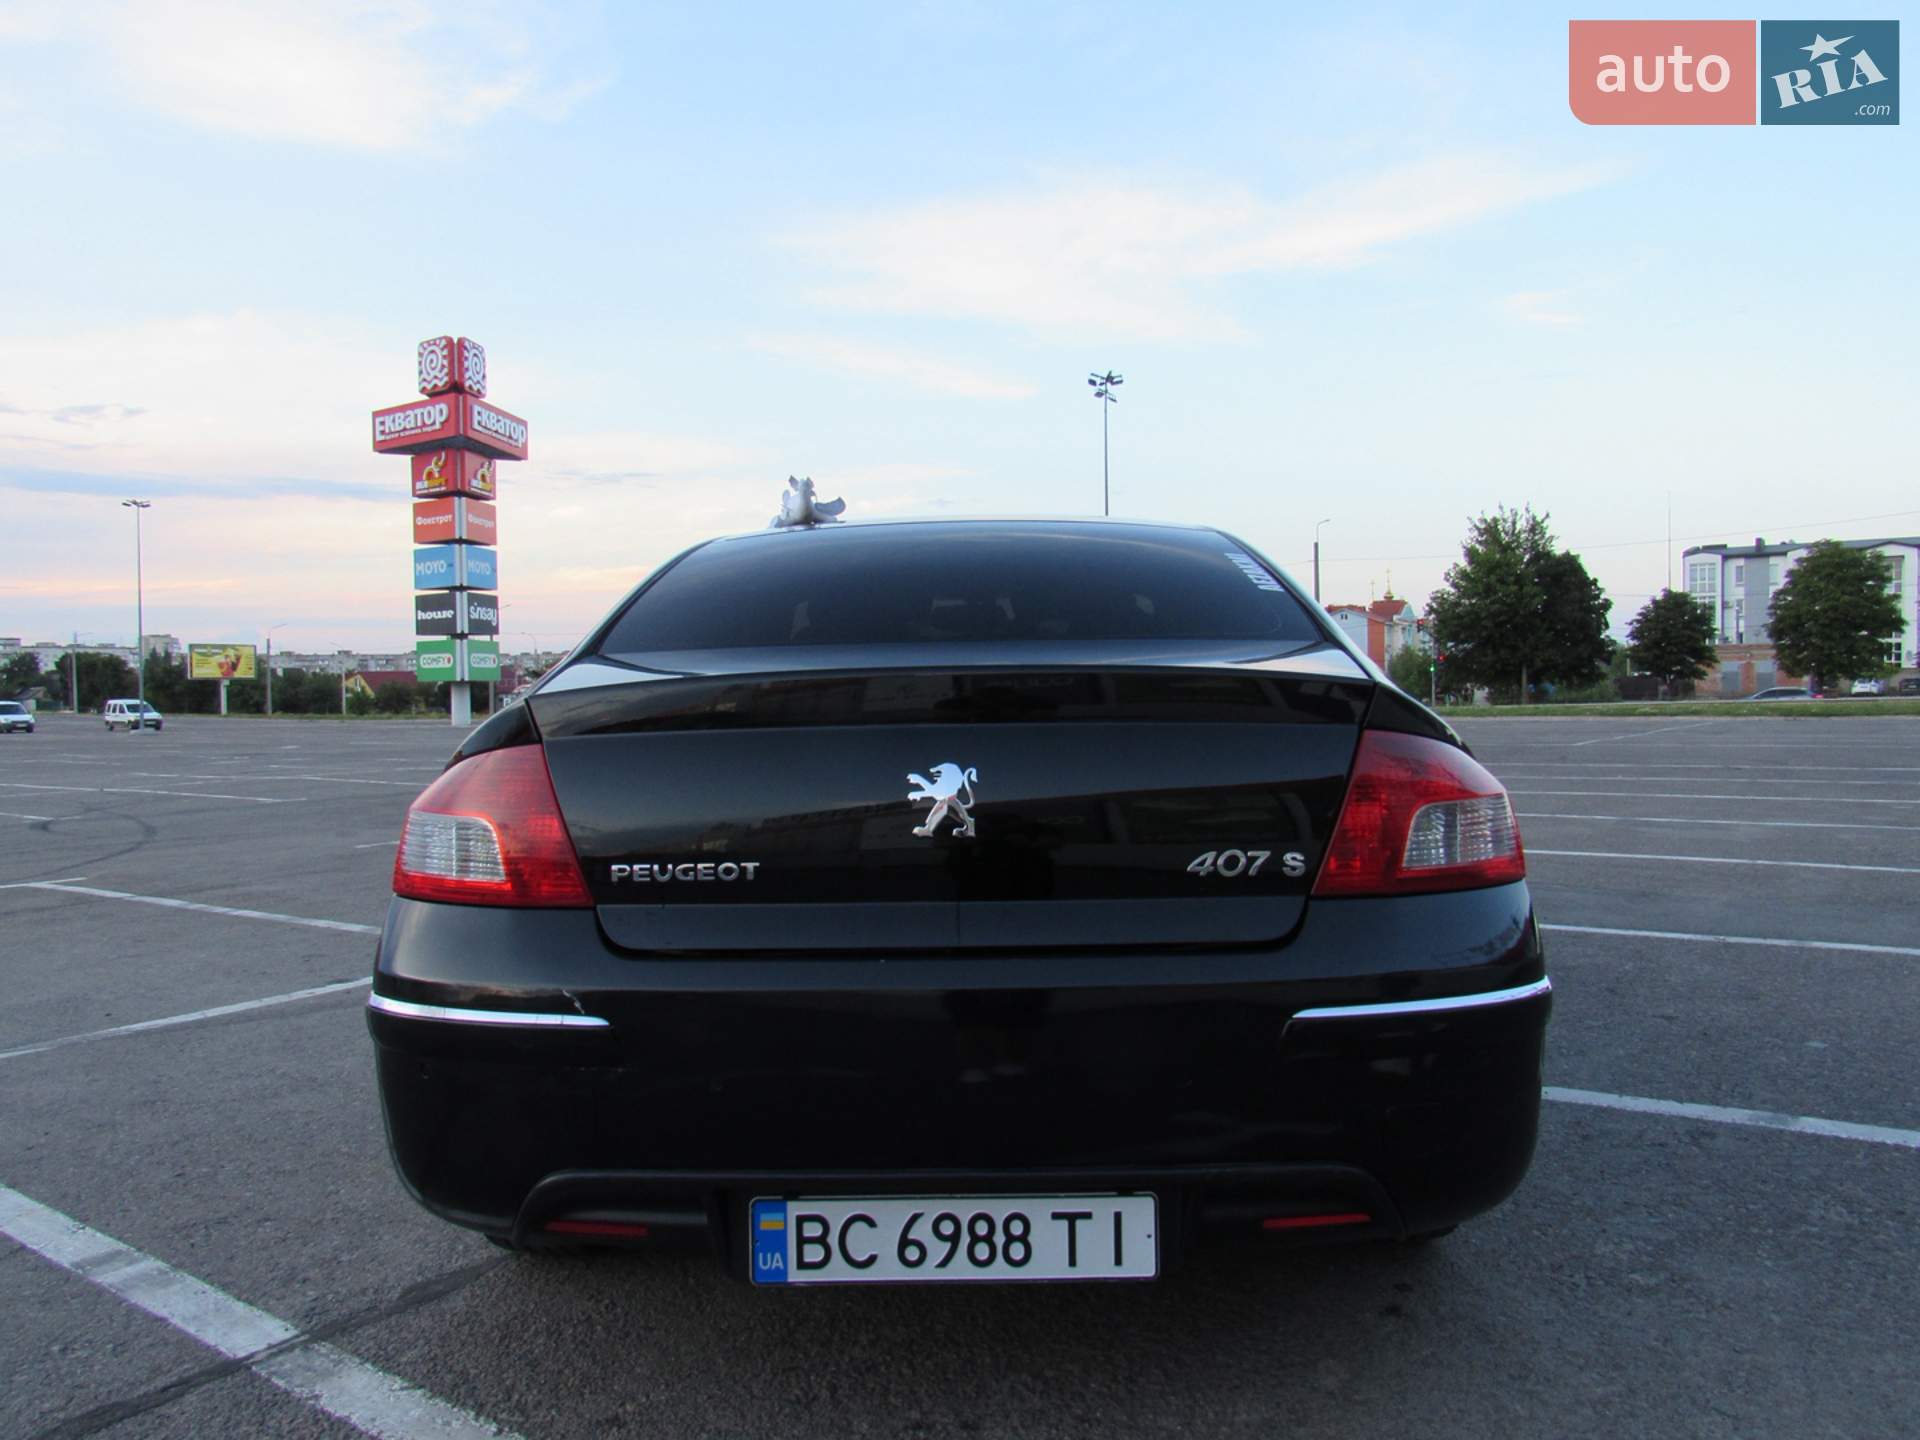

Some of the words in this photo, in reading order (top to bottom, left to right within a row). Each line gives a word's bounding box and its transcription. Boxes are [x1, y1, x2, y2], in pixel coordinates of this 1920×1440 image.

[416, 514, 453, 526] Фокстрот
[417, 609, 455, 620] house
[469, 602, 497, 626] sinsay
[610, 862, 760, 882] PEUGEOT
[1186, 849, 1271, 877] 407
[1282, 851, 1306, 877] S
[795, 1212, 878, 1270] BC
[896, 1211, 1032, 1268] 6988
[758, 1252, 785, 1270] UA
